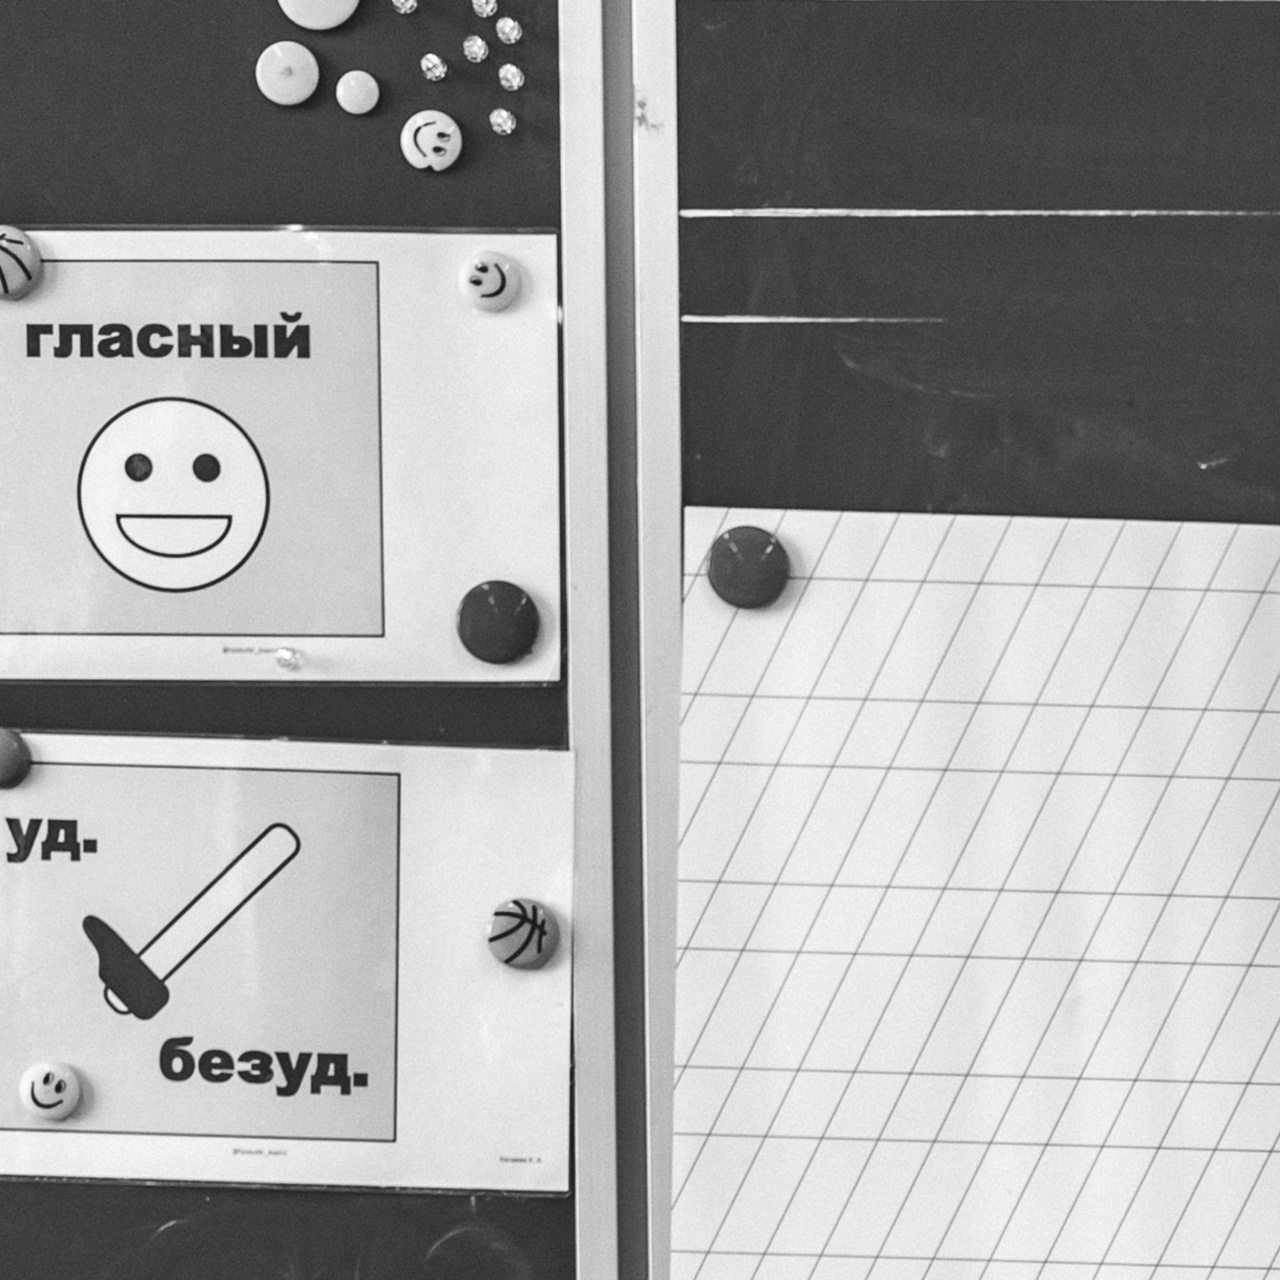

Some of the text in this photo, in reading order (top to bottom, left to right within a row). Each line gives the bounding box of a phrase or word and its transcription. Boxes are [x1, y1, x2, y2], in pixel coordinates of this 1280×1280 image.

[26, 311, 312, 359] гласный
[4, 816, 99, 864] уд.
[158, 1035, 370, 1098] безуд.
